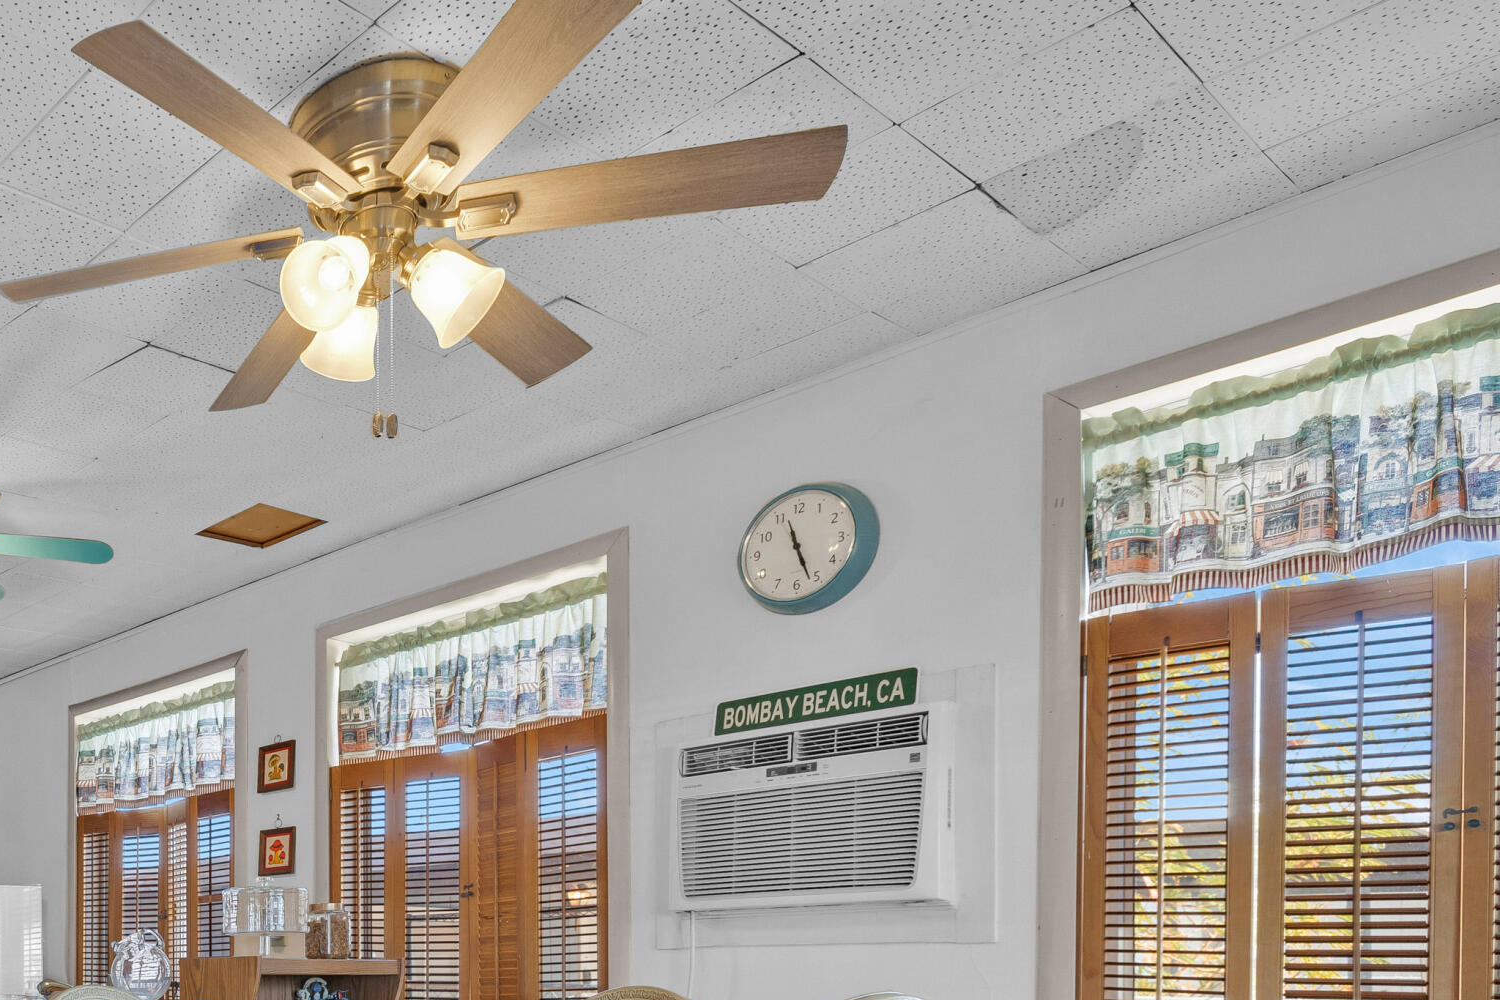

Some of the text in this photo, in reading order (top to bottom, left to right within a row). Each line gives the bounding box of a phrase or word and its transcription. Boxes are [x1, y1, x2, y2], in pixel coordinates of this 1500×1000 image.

[793, 502, 805, 514] 12
[817, 503, 822, 513] 1
[775, 513, 785, 525] 11
[831, 512, 839, 524] 2
[760, 531, 773, 543] 10
[838, 531, 845, 543] 3
[753, 551, 761, 561] 9
[828, 554, 836, 564] 4
[813, 570, 820, 581] 5
[774, 578, 782, 589] 7
[792, 579, 800, 590] 6
[723, 677, 905, 730] BOMBAY BEACH, CA
